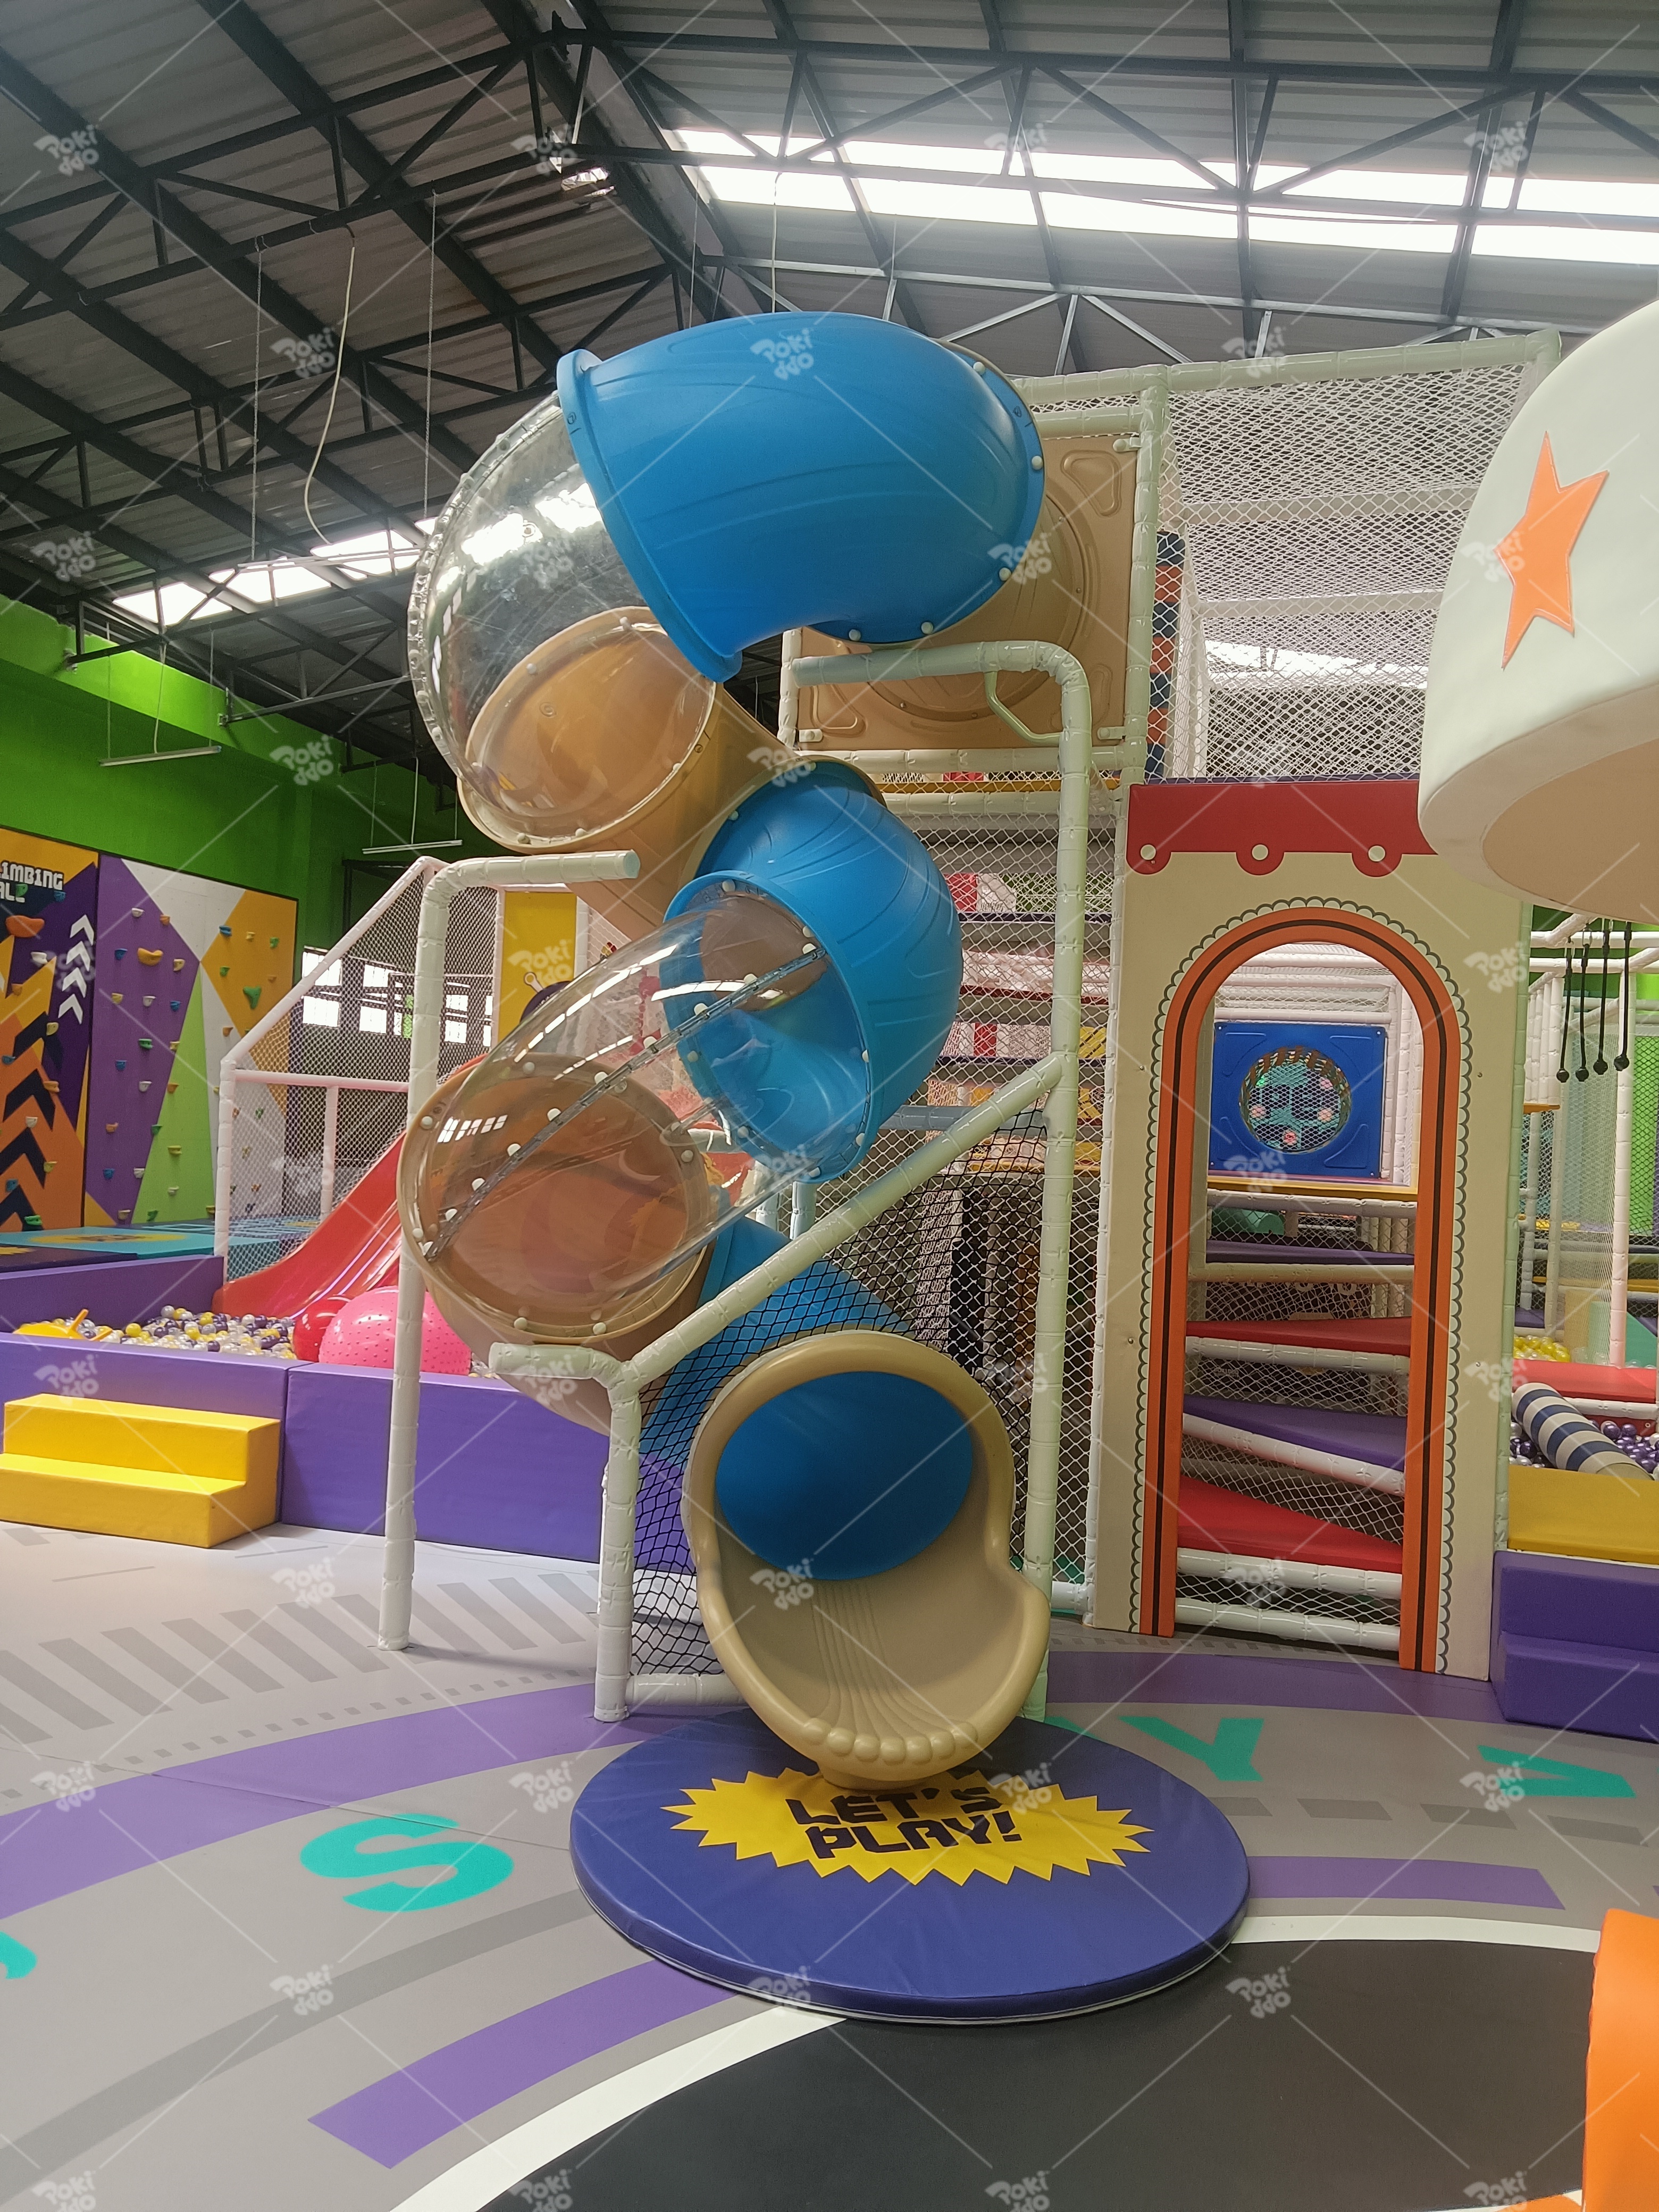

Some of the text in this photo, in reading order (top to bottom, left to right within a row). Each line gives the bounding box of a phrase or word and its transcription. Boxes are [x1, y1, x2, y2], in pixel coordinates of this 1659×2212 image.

[0, 862, 63, 890] IMBING
[784, 1787, 1003, 1825] LET'S
[805, 1811, 1023, 1858] PLAY!
[299, 1813, 514, 1912] S
